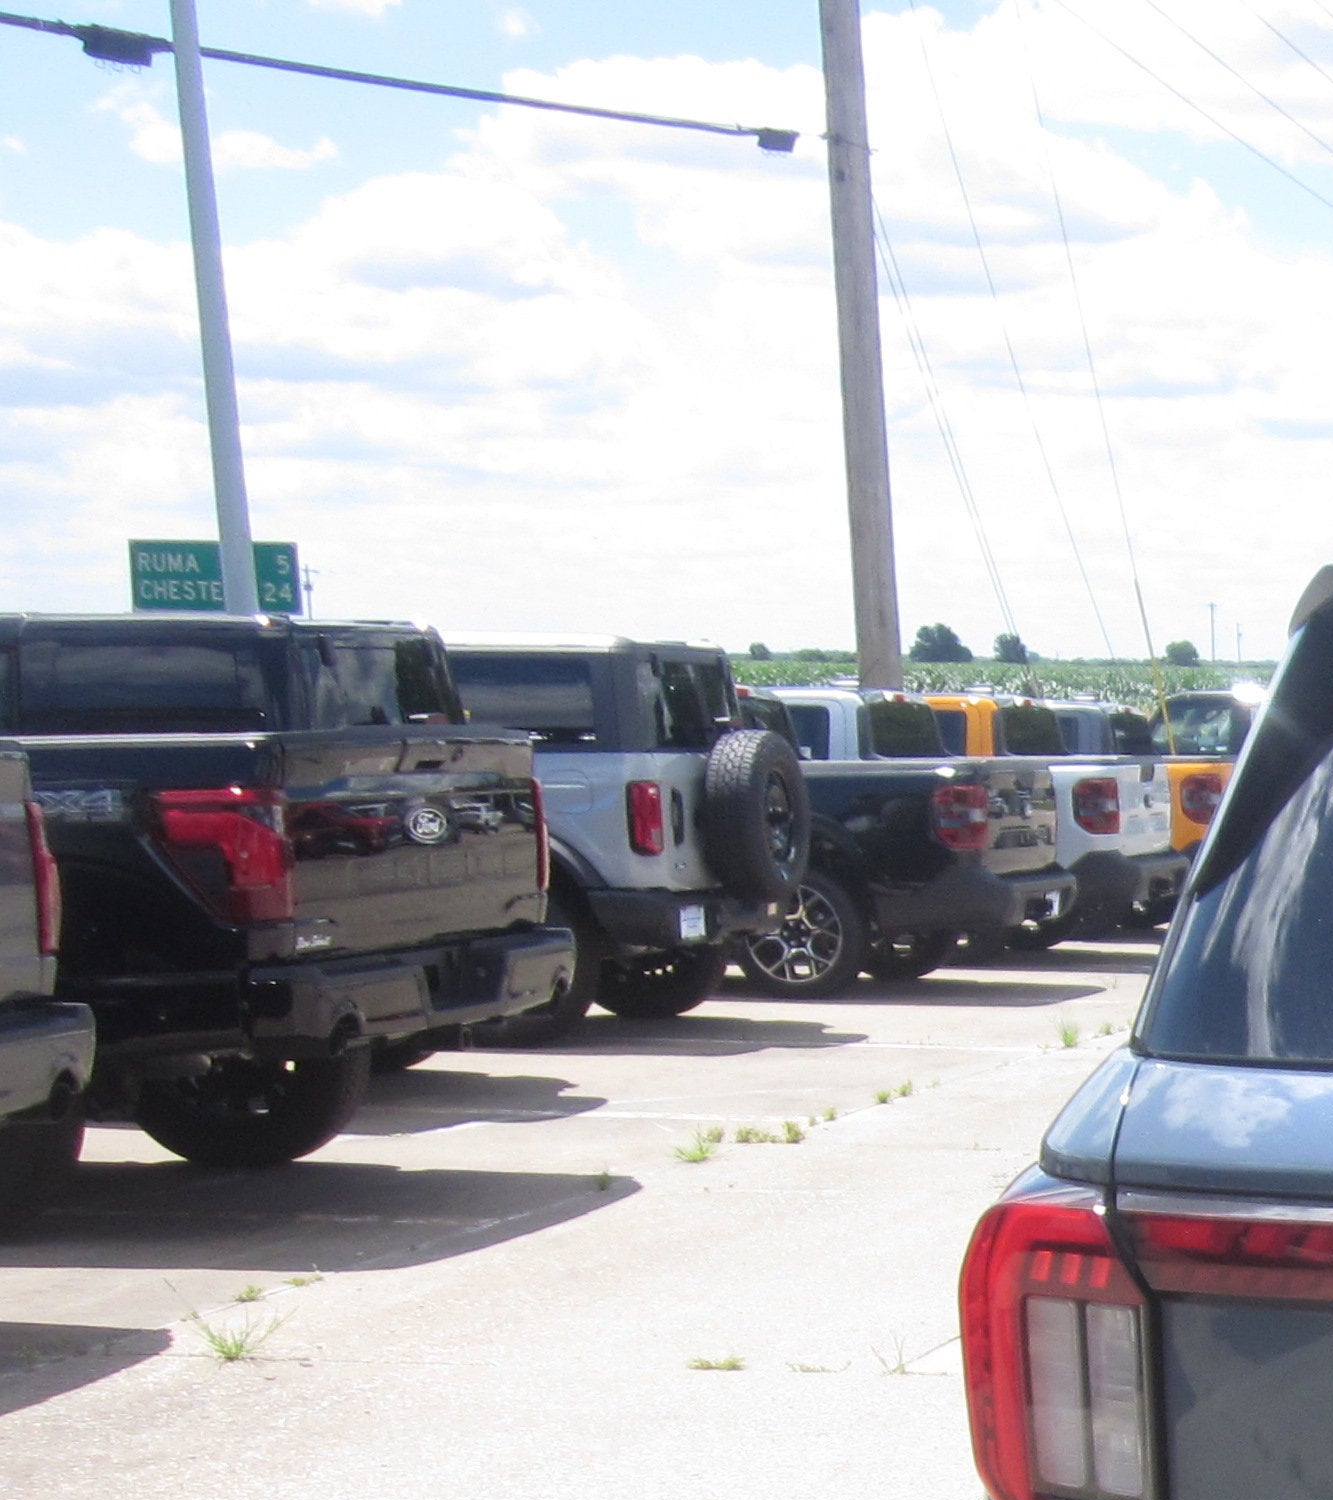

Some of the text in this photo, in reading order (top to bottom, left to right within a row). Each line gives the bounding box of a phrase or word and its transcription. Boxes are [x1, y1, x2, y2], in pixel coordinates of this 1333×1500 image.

[136, 551, 290, 575] RUMA 5
[138, 579, 292, 602] CHESTE 24
